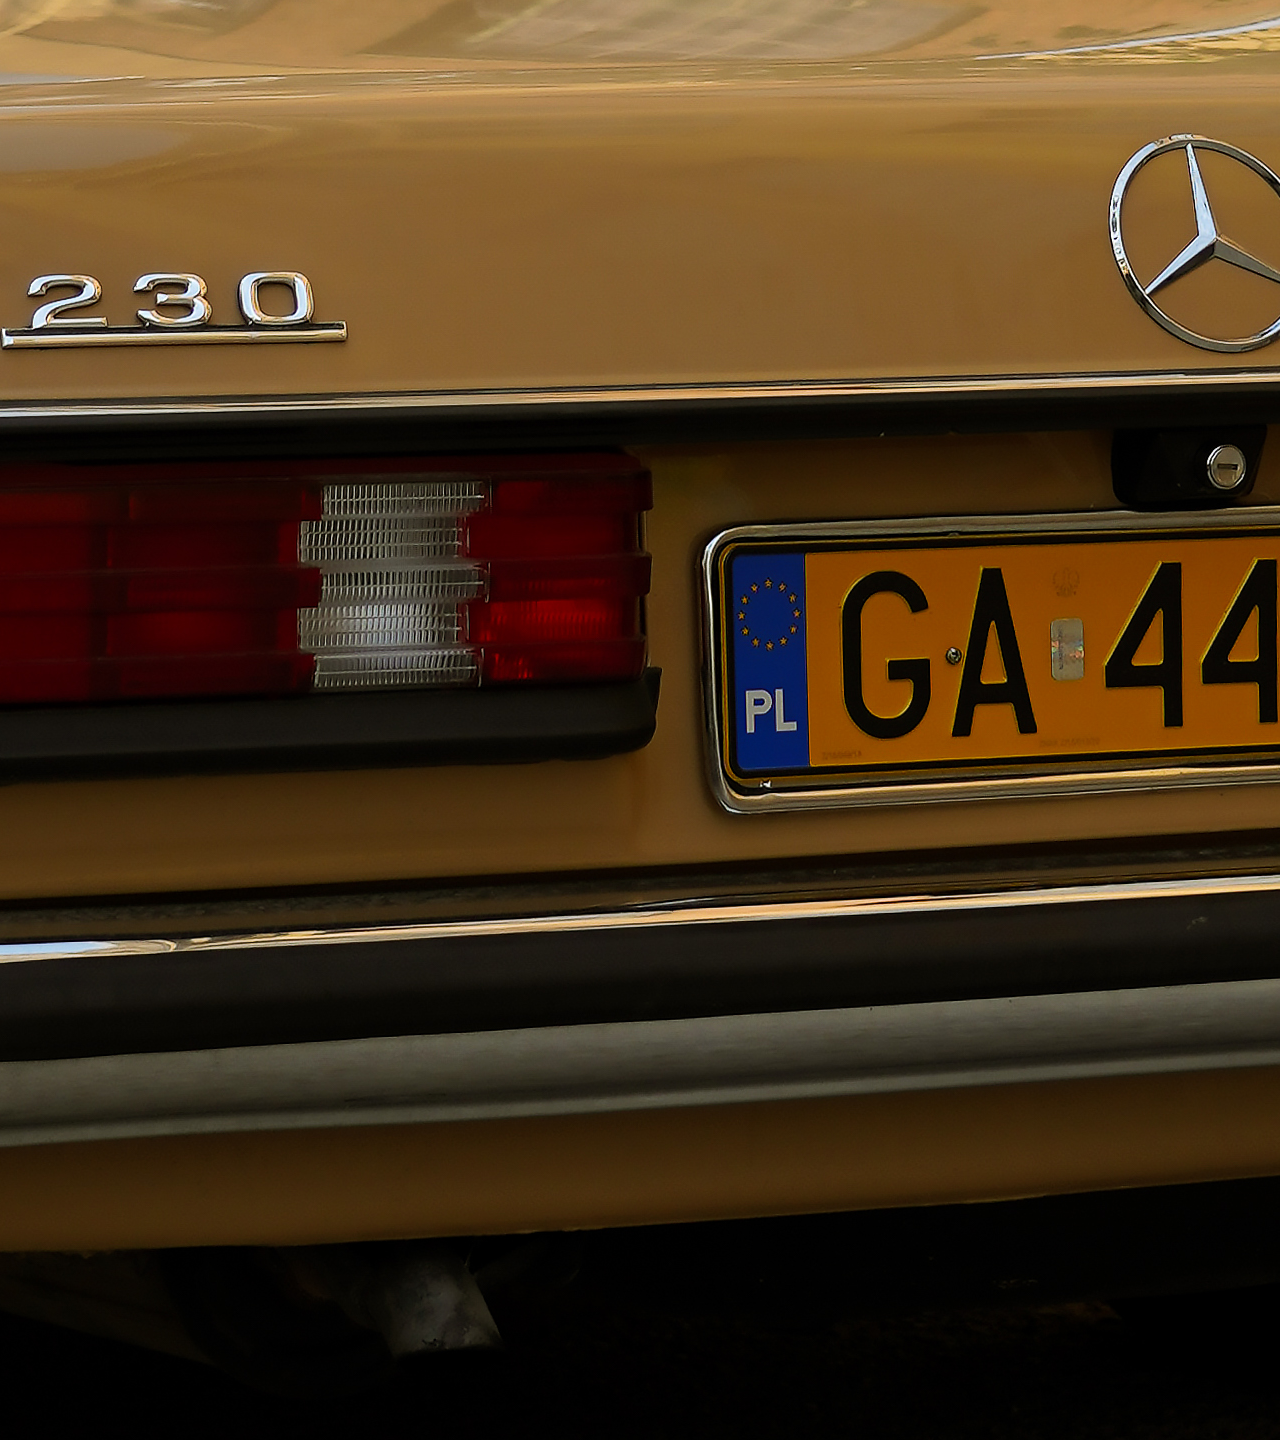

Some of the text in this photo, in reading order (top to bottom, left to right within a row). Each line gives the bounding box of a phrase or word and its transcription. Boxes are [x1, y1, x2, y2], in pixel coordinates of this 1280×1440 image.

[26, 270, 316, 328] 230
[839, 566, 1040, 741] GA
[744, 688, 798, 734] PL
